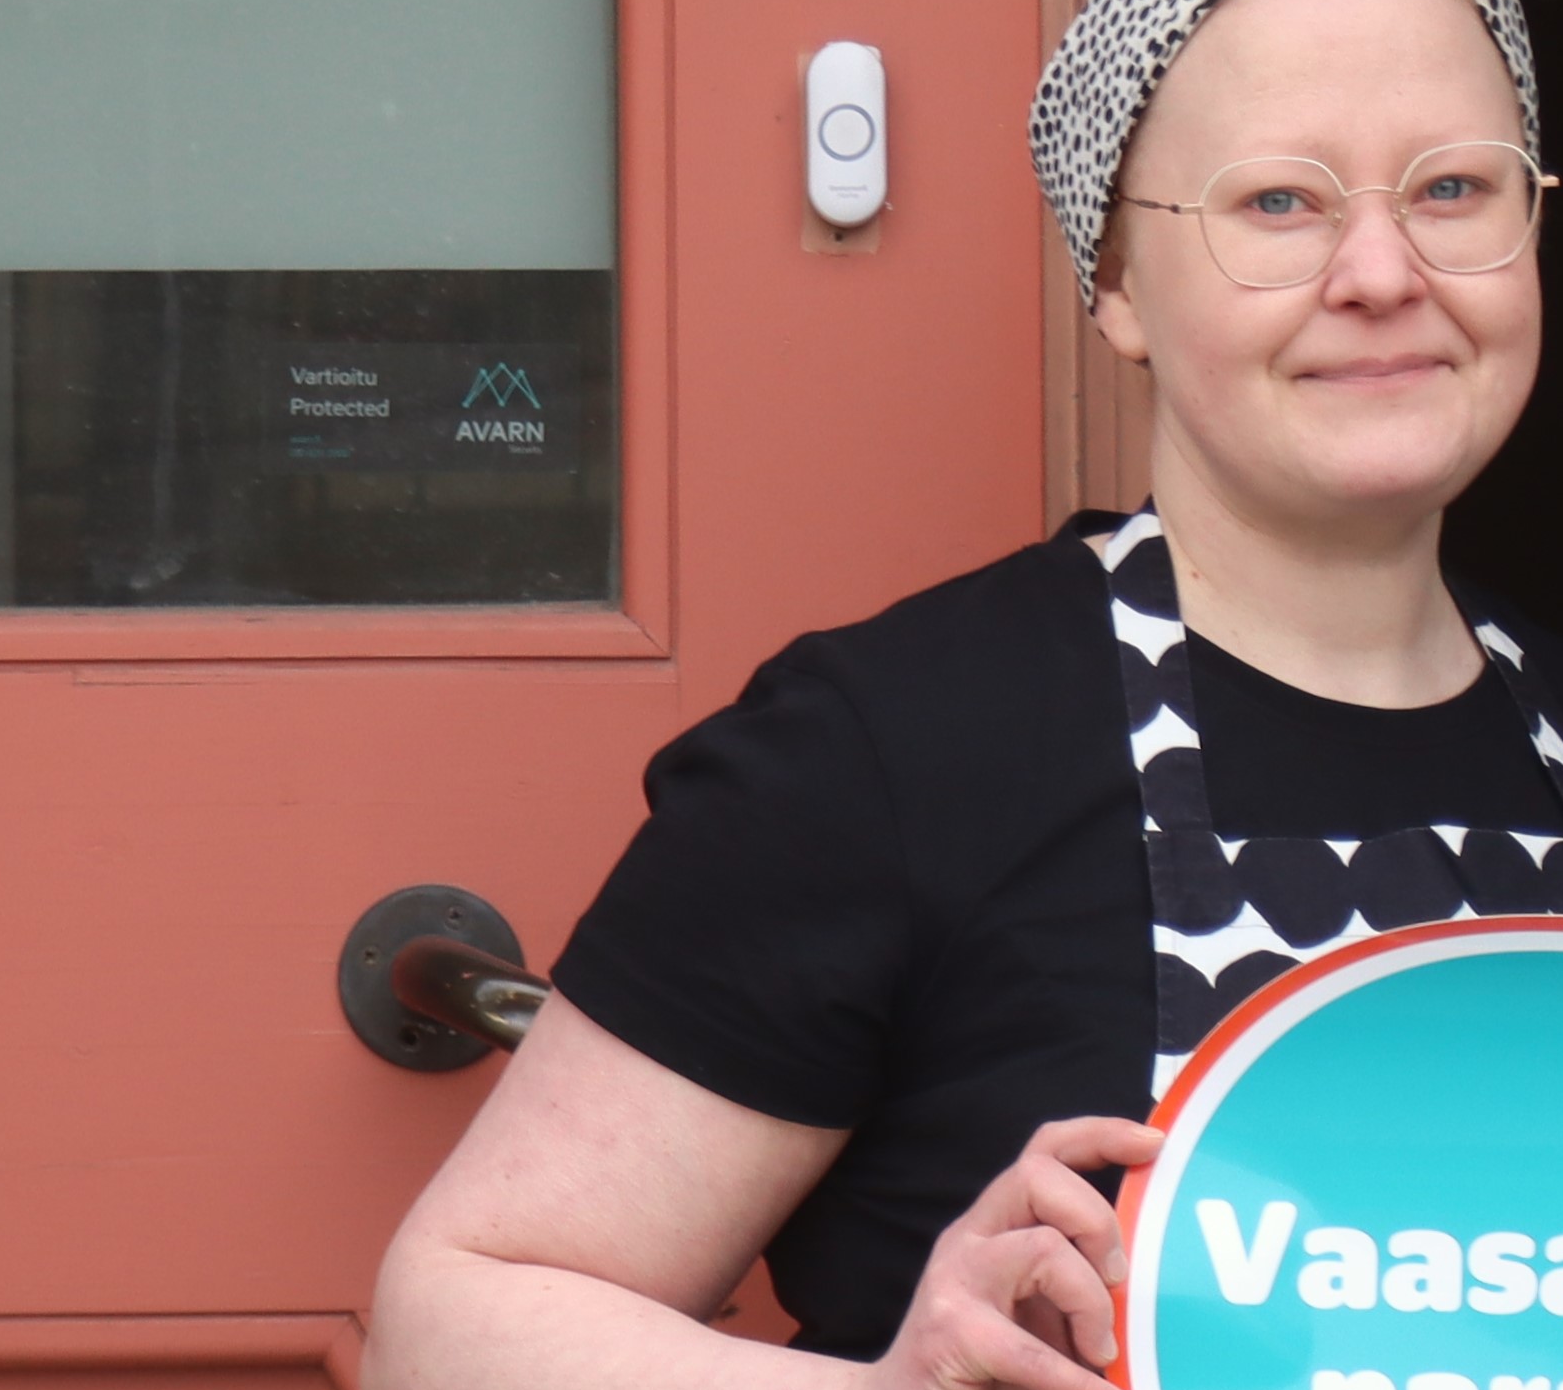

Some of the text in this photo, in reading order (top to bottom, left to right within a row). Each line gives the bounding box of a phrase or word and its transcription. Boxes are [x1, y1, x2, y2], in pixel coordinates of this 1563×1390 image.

[290, 366, 378, 386] Vartioitu
[290, 397, 390, 417] Protected
[455, 420, 545, 443] AVARN
